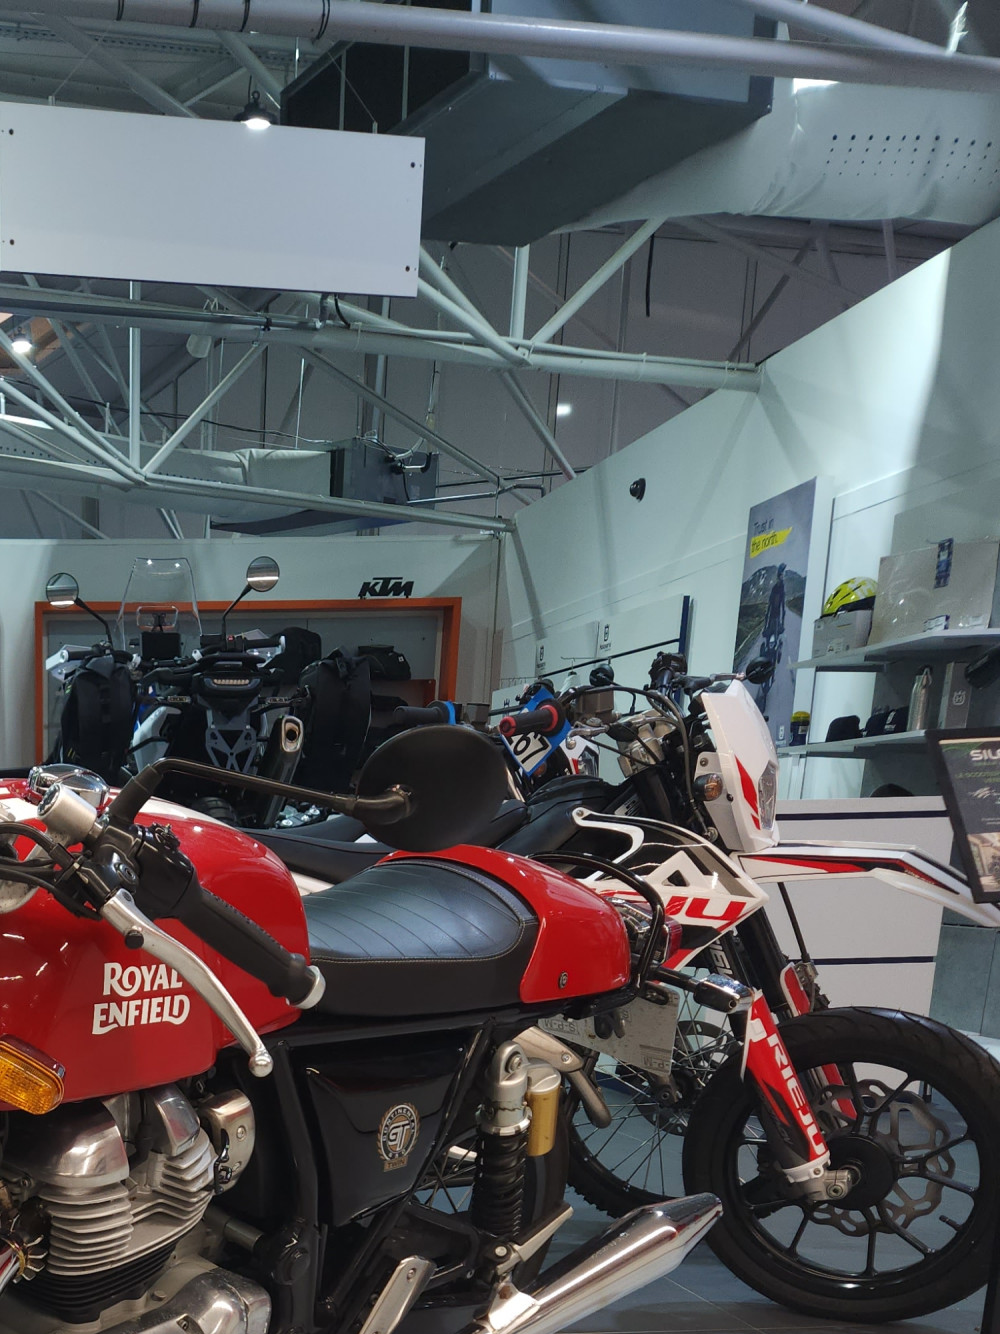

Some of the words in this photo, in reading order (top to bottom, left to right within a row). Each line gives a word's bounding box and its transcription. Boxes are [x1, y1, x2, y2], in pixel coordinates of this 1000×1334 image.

[358, 577, 414, 597] KTM
[969, 748, 1000, 761] SIL
[103, 962, 183, 997] ROYAL
[92, 994, 190, 1035] ENFIELD
[767, 1033, 827, 1155] RIEJU
[382, 1108, 415, 1141] CONTINENTAL
[388, 1120, 411, 1151] GT
